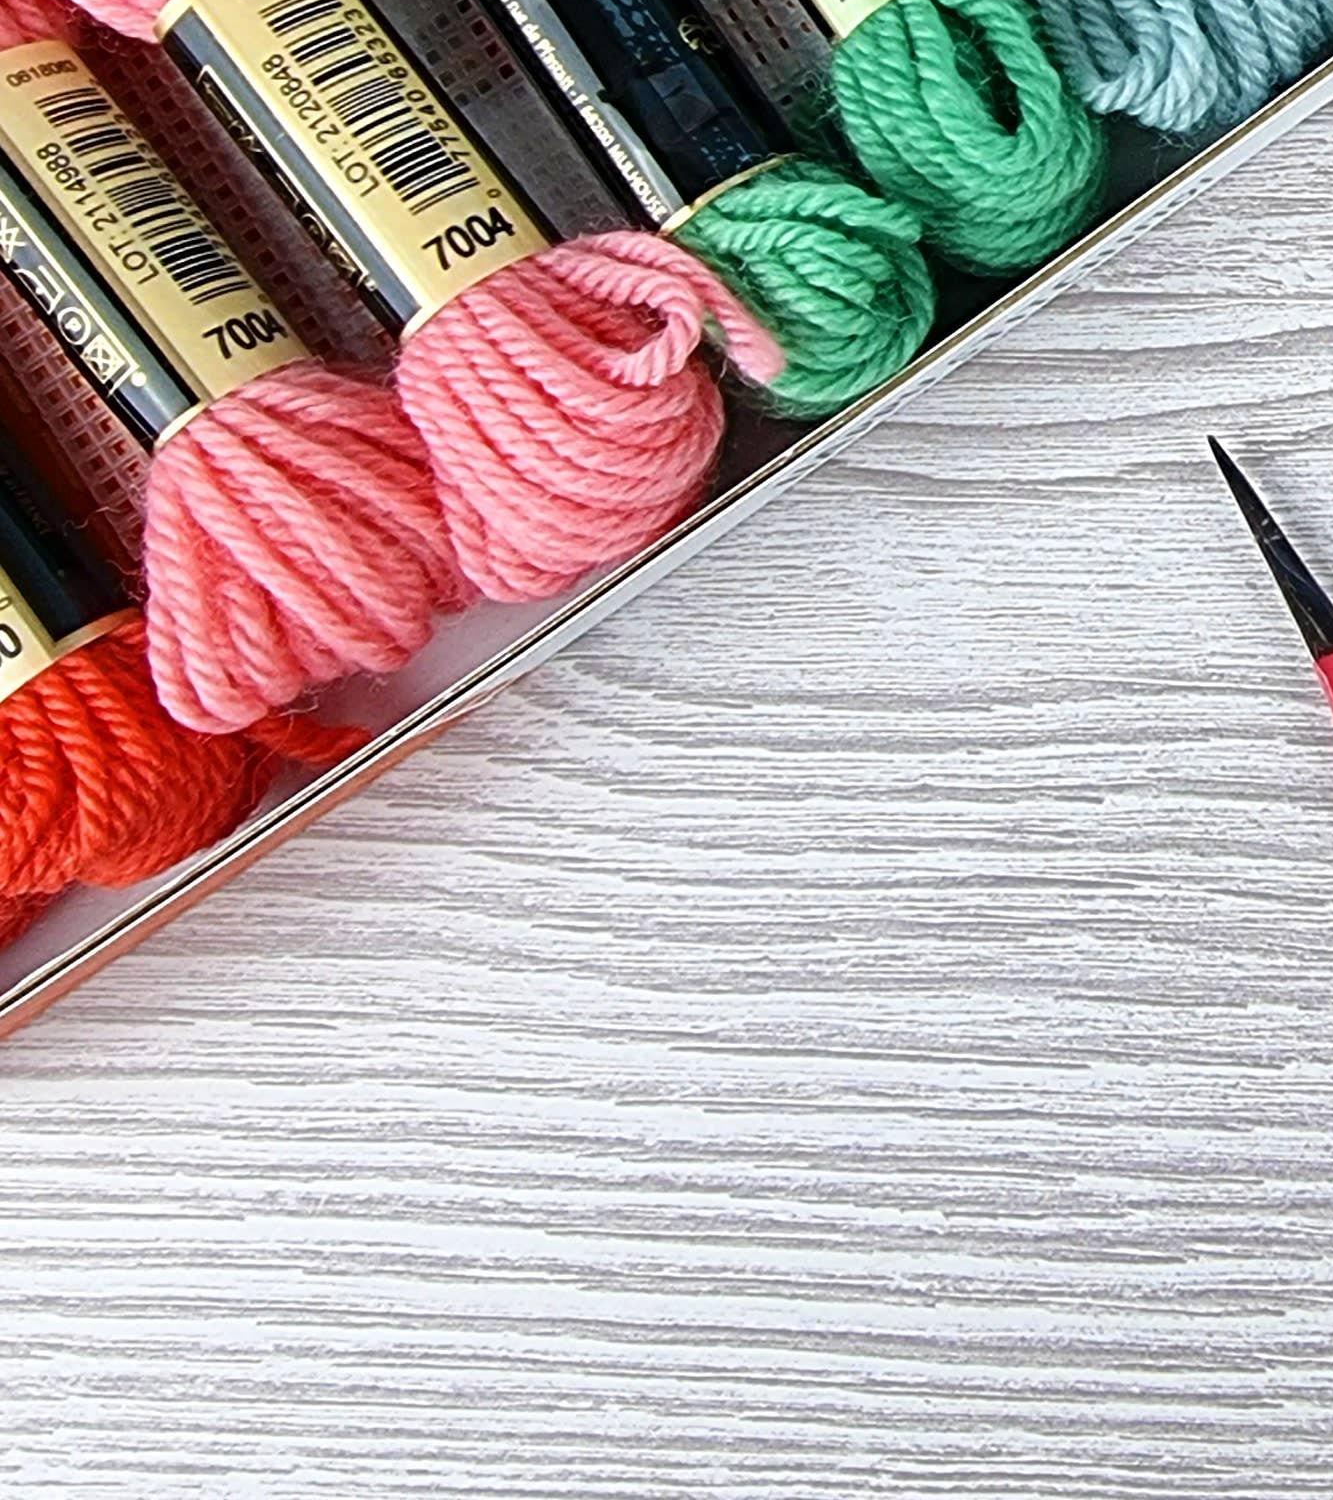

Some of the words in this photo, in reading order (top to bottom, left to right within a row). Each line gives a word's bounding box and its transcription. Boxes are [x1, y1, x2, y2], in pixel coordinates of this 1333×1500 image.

[344, 8, 410, 83] 65323
[262, 53, 340, 145] 2120848
[407, 89, 471, 164] 77540
[507, 1, 528, 25] rue
[522, 23, 541, 44] de
[608, 144, 668, 223] MULHOUSE
[36, 142, 119, 232] 2114988
[421, 206, 515, 270] 7004
[202, 309, 288, 360] 7004
